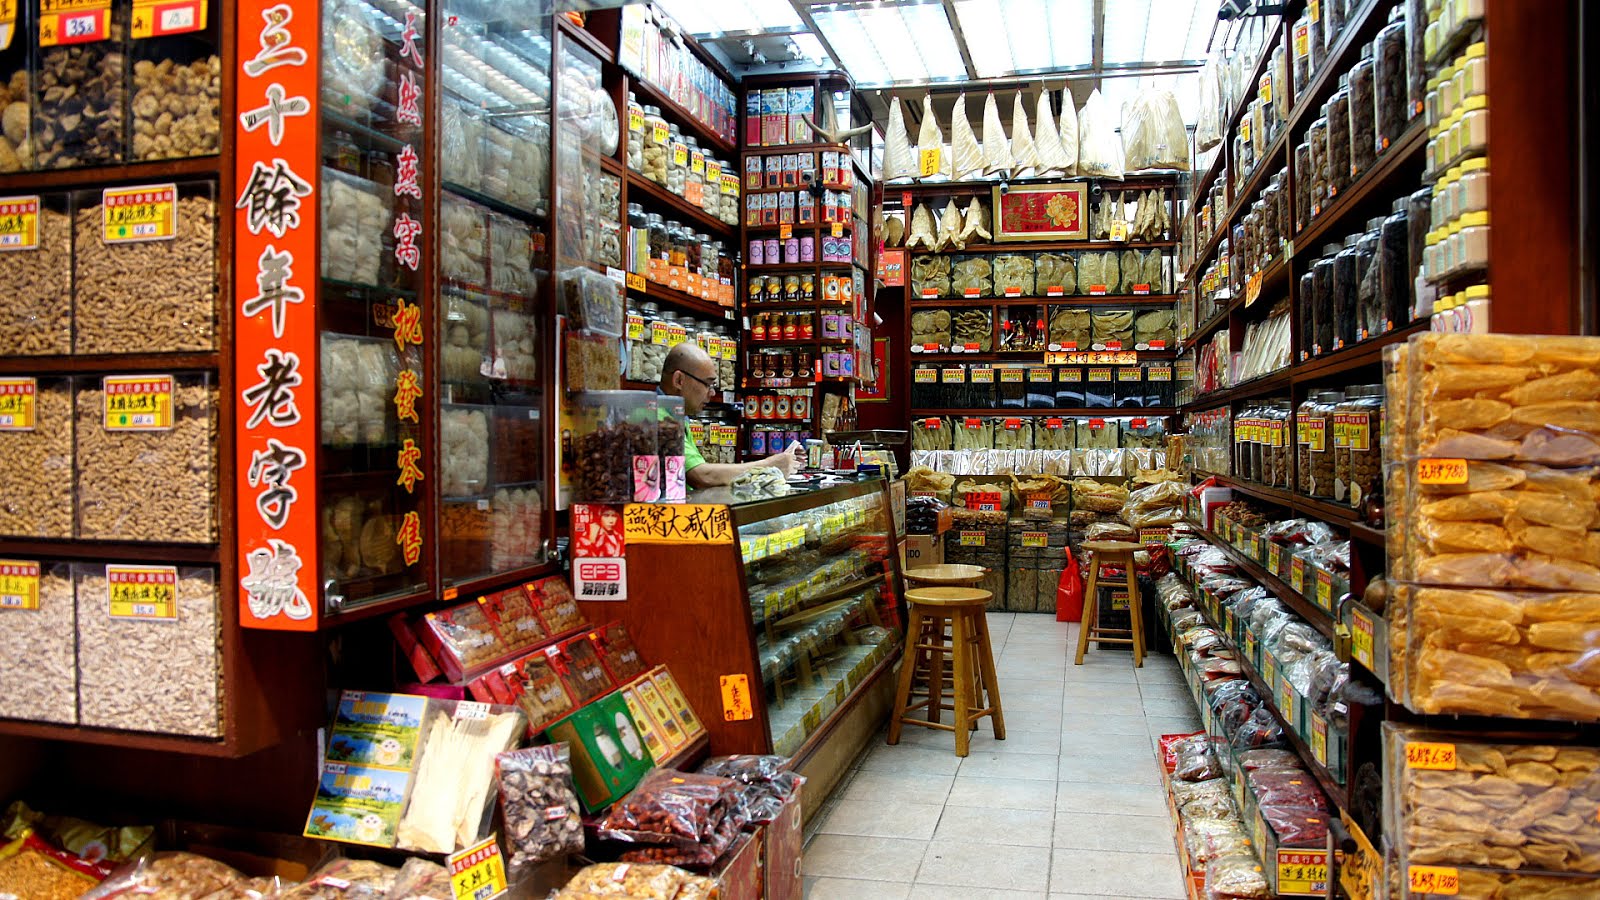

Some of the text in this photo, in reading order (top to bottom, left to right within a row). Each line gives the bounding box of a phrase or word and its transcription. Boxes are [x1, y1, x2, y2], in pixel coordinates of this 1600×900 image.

[393, 12, 424, 271] 天然燕窩
[236, 4, 313, 620] 三十餘年老字號
[392, 298, 425, 567] 批發零售
[581, 565, 619, 580] EPS
[1279, 854, 1328, 865] 健成行參
